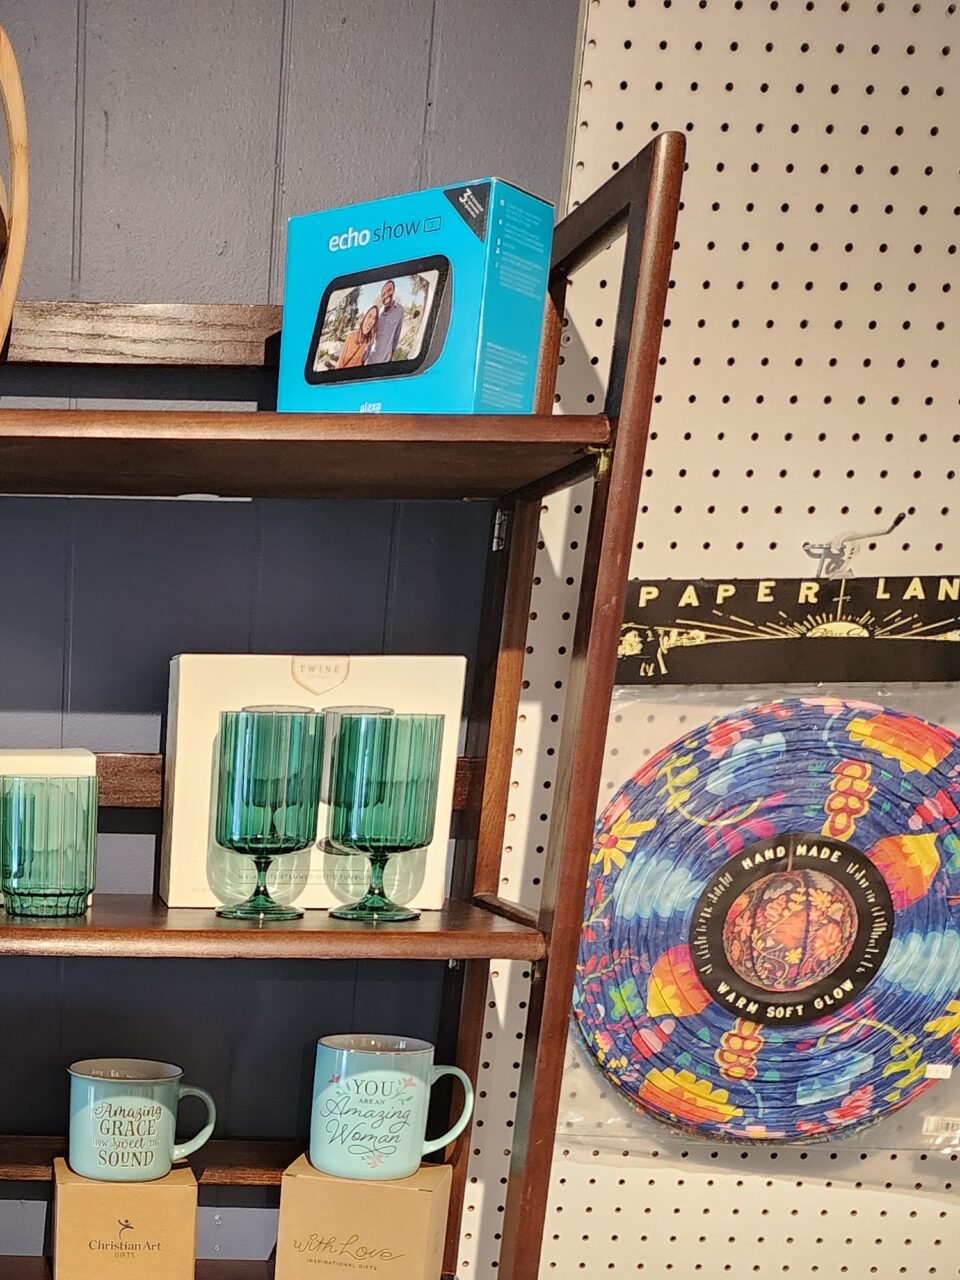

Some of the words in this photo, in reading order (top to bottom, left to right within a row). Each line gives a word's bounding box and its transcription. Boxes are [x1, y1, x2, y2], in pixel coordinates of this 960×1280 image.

[328, 227, 370, 252] echo
[373, 220, 421, 243] show
[360, 402, 382, 414] alexa
[638, 580, 821, 608] PAPER
[300, 665, 340, 673] TWINE
[742, 845, 786, 870] HAND
[796, 844, 842, 863] MADE
[717, 982, 759, 1014] WARM
[766, 1005, 804, 1018] SOFT
[814, 979, 855, 1009] GLOW
[353, 1079, 394, 1096] YOU
[94, 1101, 162, 1121] Amazing
[320, 1096, 412, 1133] Amazing
[100, 1119, 156, 1137] GRACE
[326, 1119, 401, 1147] Woman
[111, 1137, 145, 1150] sweet
[98, 1150, 154, 1167] SOUND
[88, 1239, 141, 1251] Christian
[143, 1241, 161, 1251] Art
[339, 1234, 406, 1261] Love
[307, 1258, 356, 1269] INSPIRATIONAL
